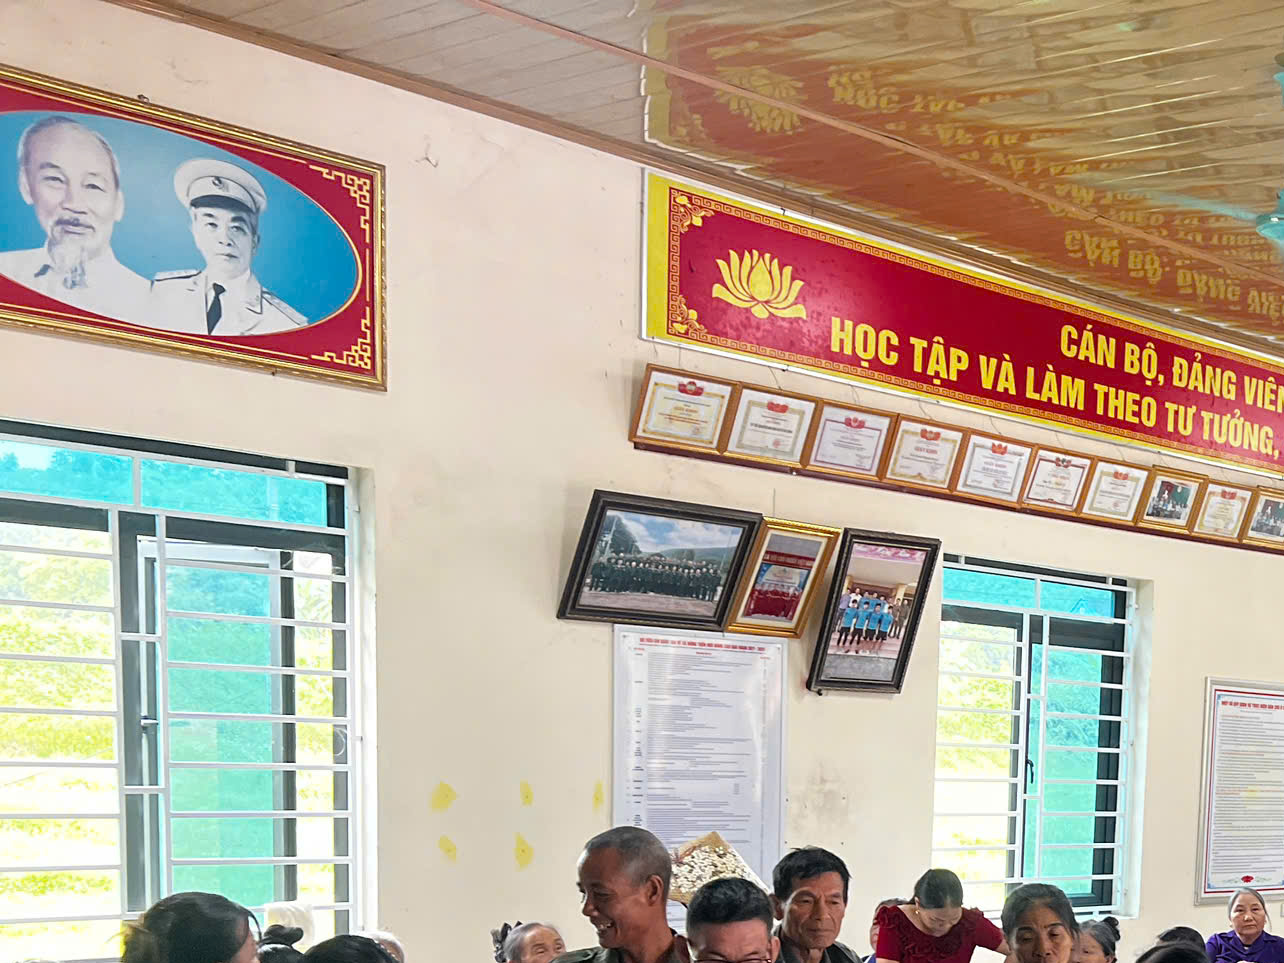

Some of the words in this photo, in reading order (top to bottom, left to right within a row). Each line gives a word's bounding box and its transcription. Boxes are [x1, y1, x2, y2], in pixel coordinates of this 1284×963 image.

[831, 316, 899, 368] HỌC
[910, 336, 969, 385] TẬP
[979, 353, 1016, 395] VÀ
[1026, 364, 1086, 411] LÀM
[1094, 382, 1157, 428] THEO
[1165, 402, 1196, 437] TƯ
[1201, 409, 1279, 460] TƯỞNG,
[1061, 324, 1115, 368] CÁN
[1125, 342, 1164, 386] BỘ,
[1172, 352, 1236, 400] ĐẢNG
